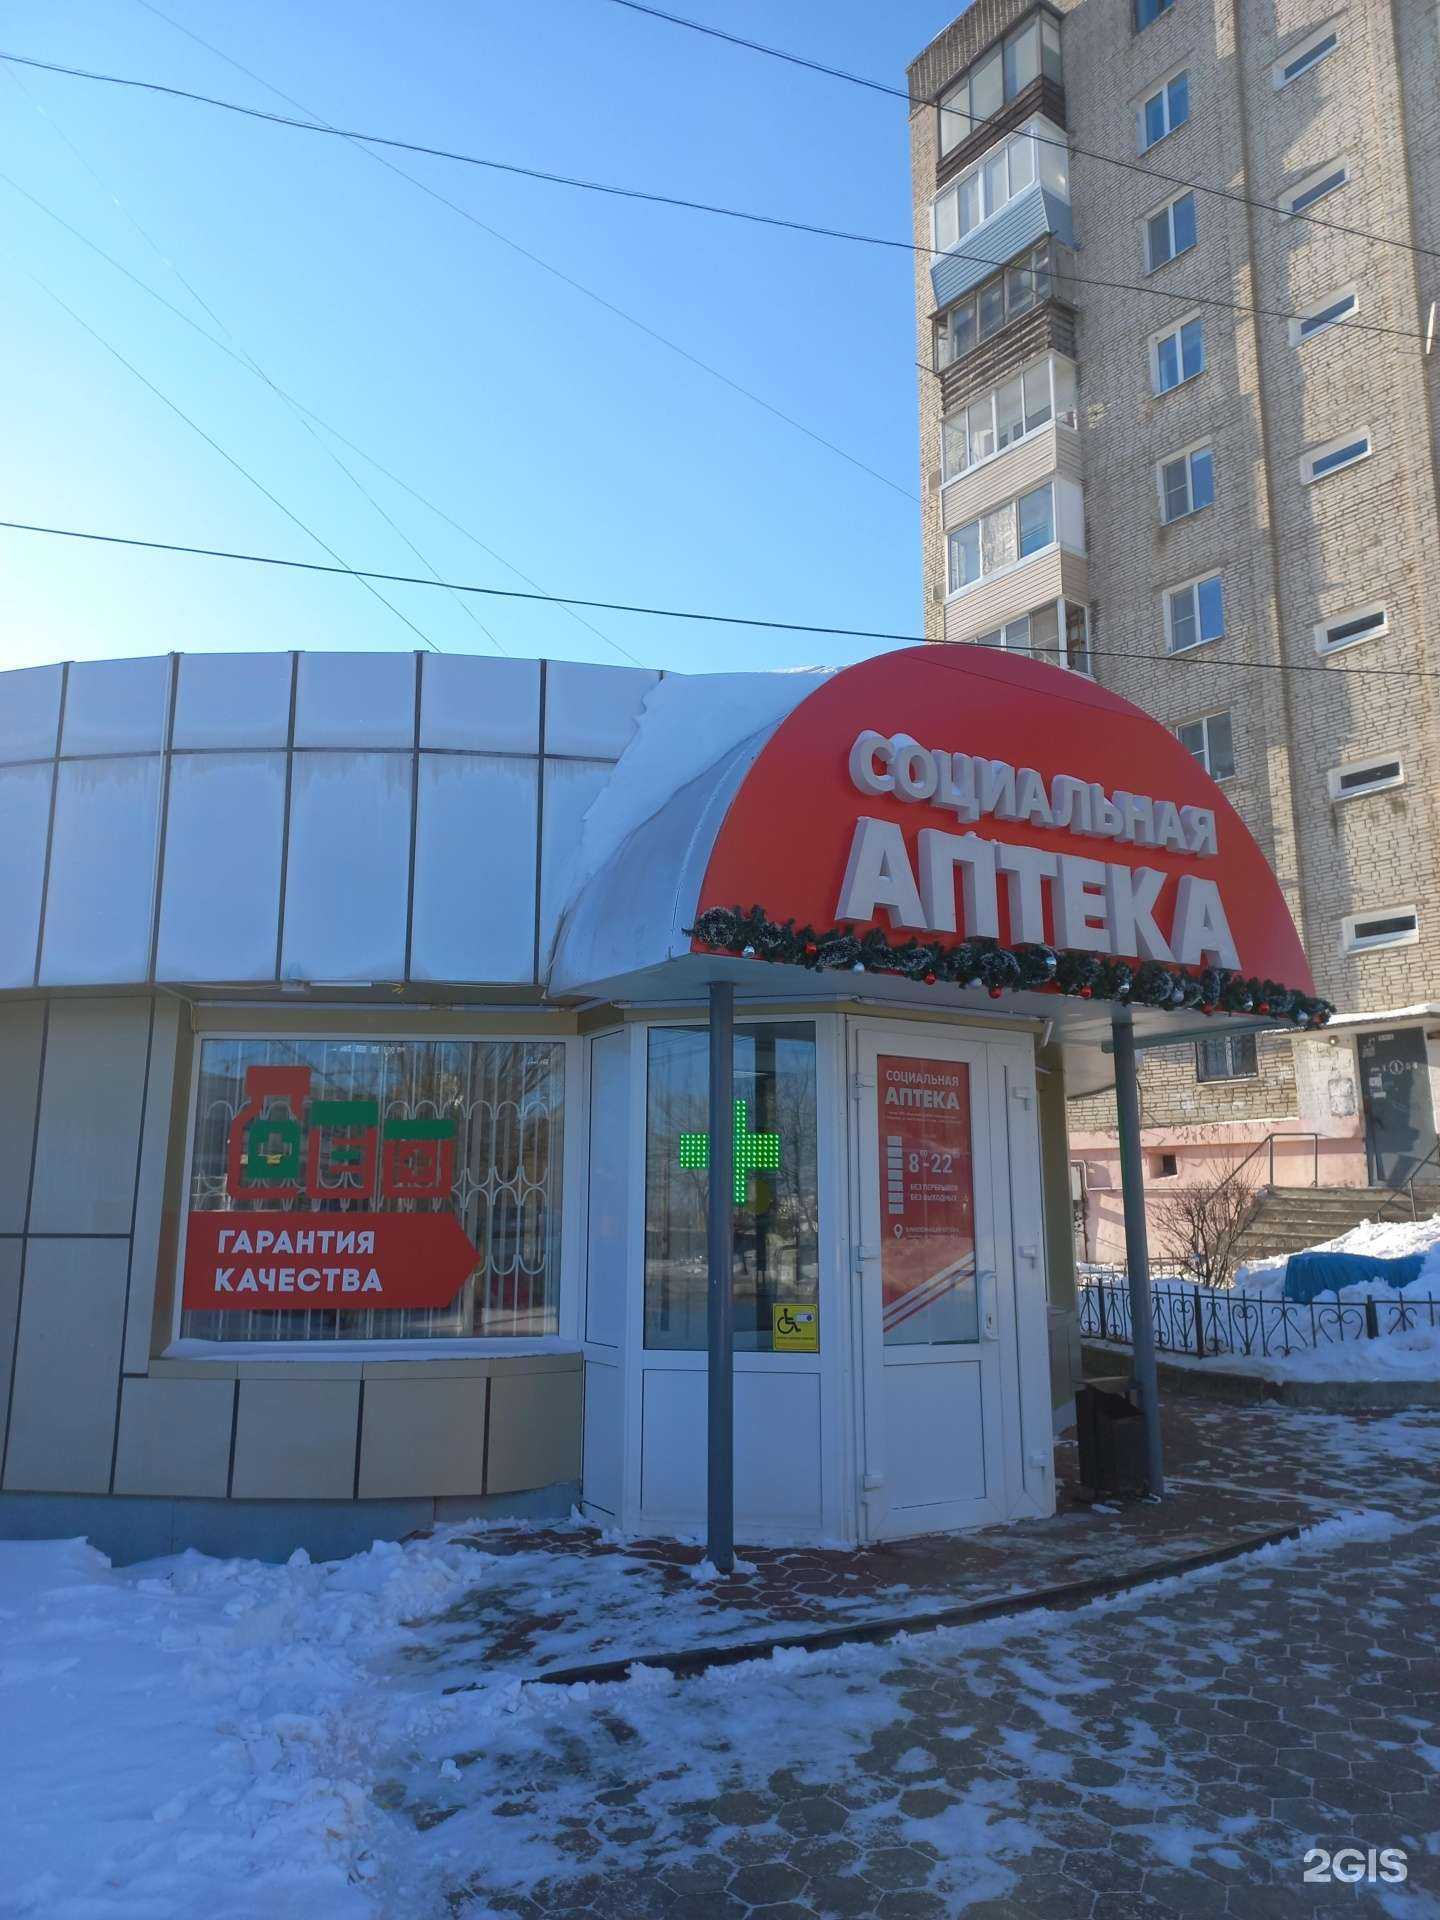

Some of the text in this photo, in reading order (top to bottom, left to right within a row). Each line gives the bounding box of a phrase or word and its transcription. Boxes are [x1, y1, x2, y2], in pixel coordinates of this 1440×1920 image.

[849, 730, 1218, 856] СОЦИАЛЬНАЯ
[835, 816, 1241, 971] АПТЕКА
[886, 1070, 960, 1087] СОЦИАЛЬНАЯ
[885, 1087, 960, 1110] АПТЕКА
[217, 1230, 375, 1254] ГАРАНТИЯ
[214, 1267, 384, 1293] КАЧЕСТВА
